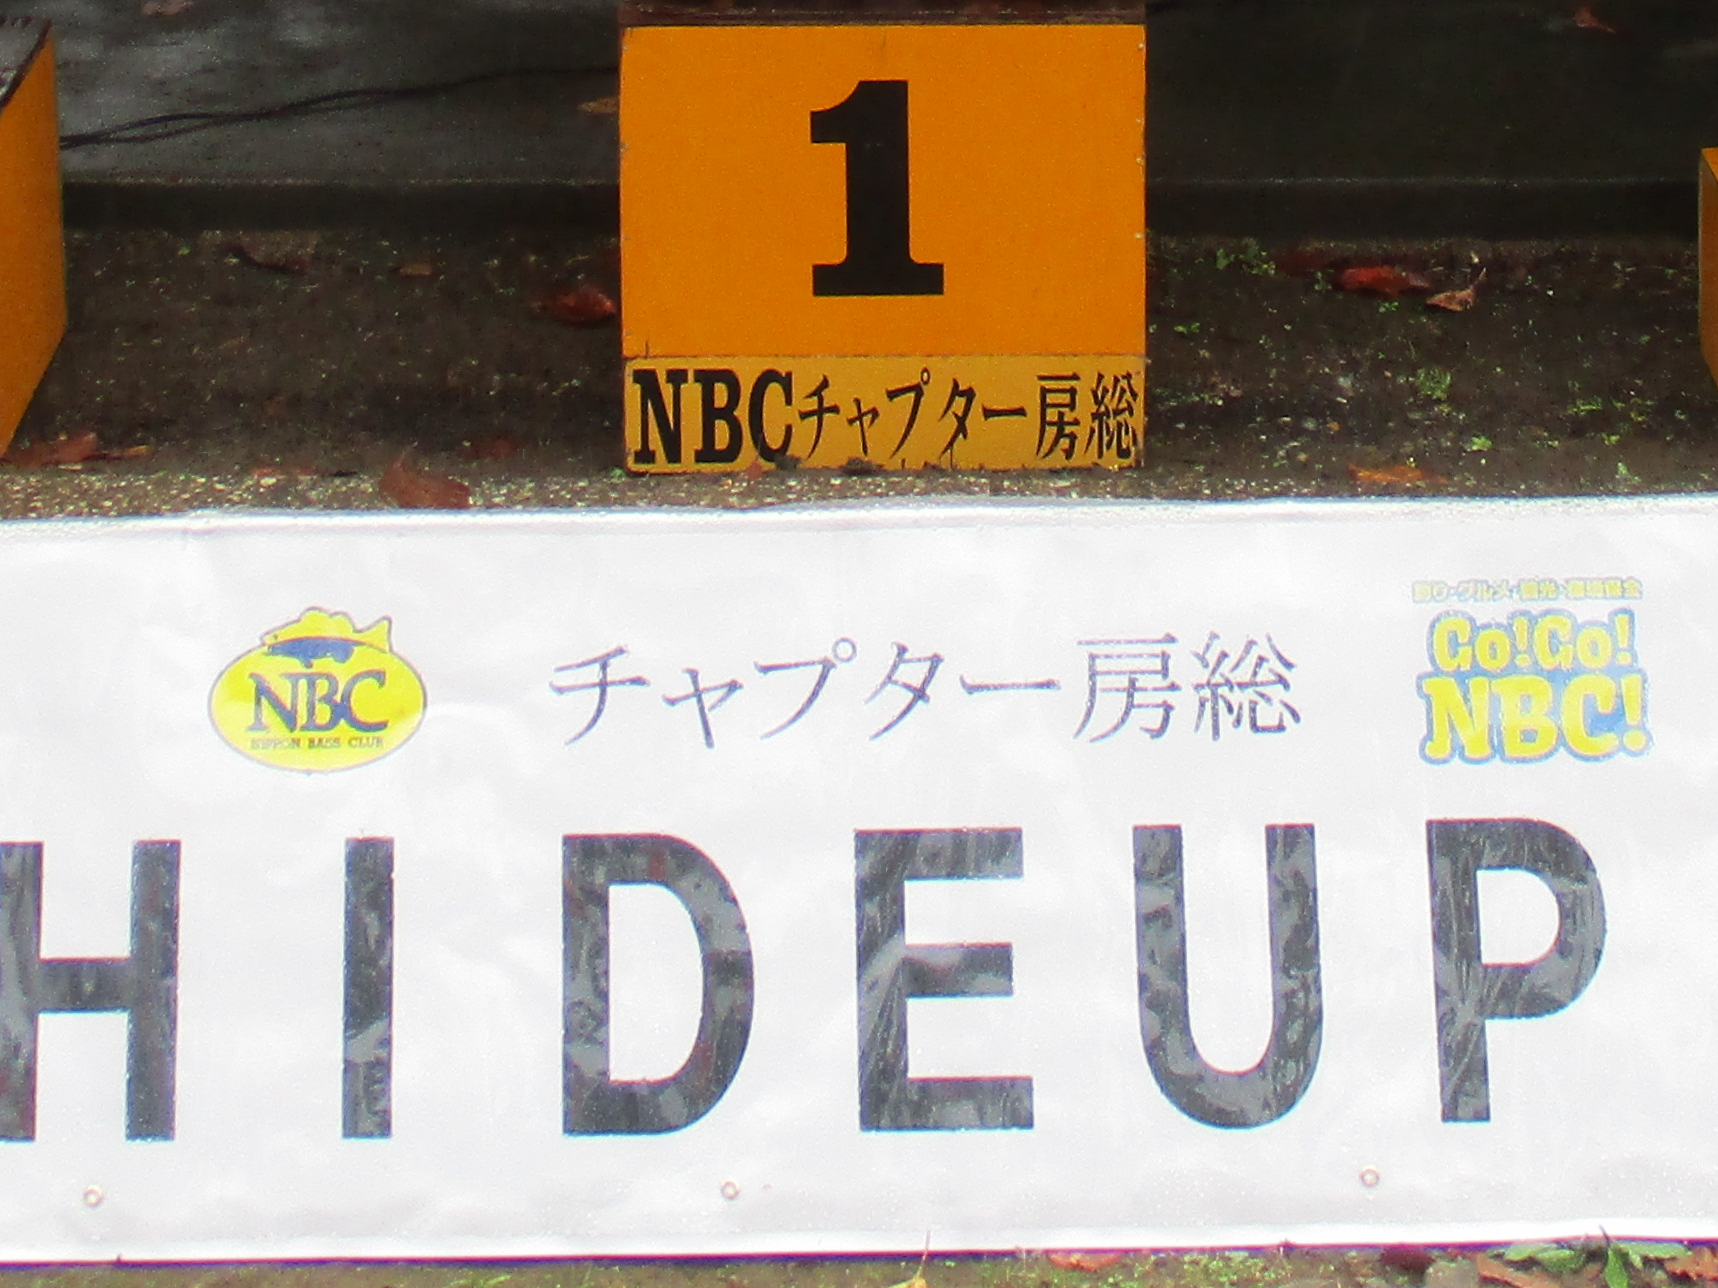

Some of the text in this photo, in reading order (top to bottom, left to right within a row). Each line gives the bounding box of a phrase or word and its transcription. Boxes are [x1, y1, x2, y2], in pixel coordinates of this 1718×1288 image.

[808, 79, 945, 296] 1
[631, 366, 1140, 465] NBCチャプター房総
[1430, 610, 1634, 673] Go!Go!
[246, 669, 389, 733] NBC
[549, 632, 1302, 749] チャプター房総
[1420, 672, 1649, 760] NBC!
[307, 736, 341, 749] BASS
[347, 736, 383, 749] CLUB
